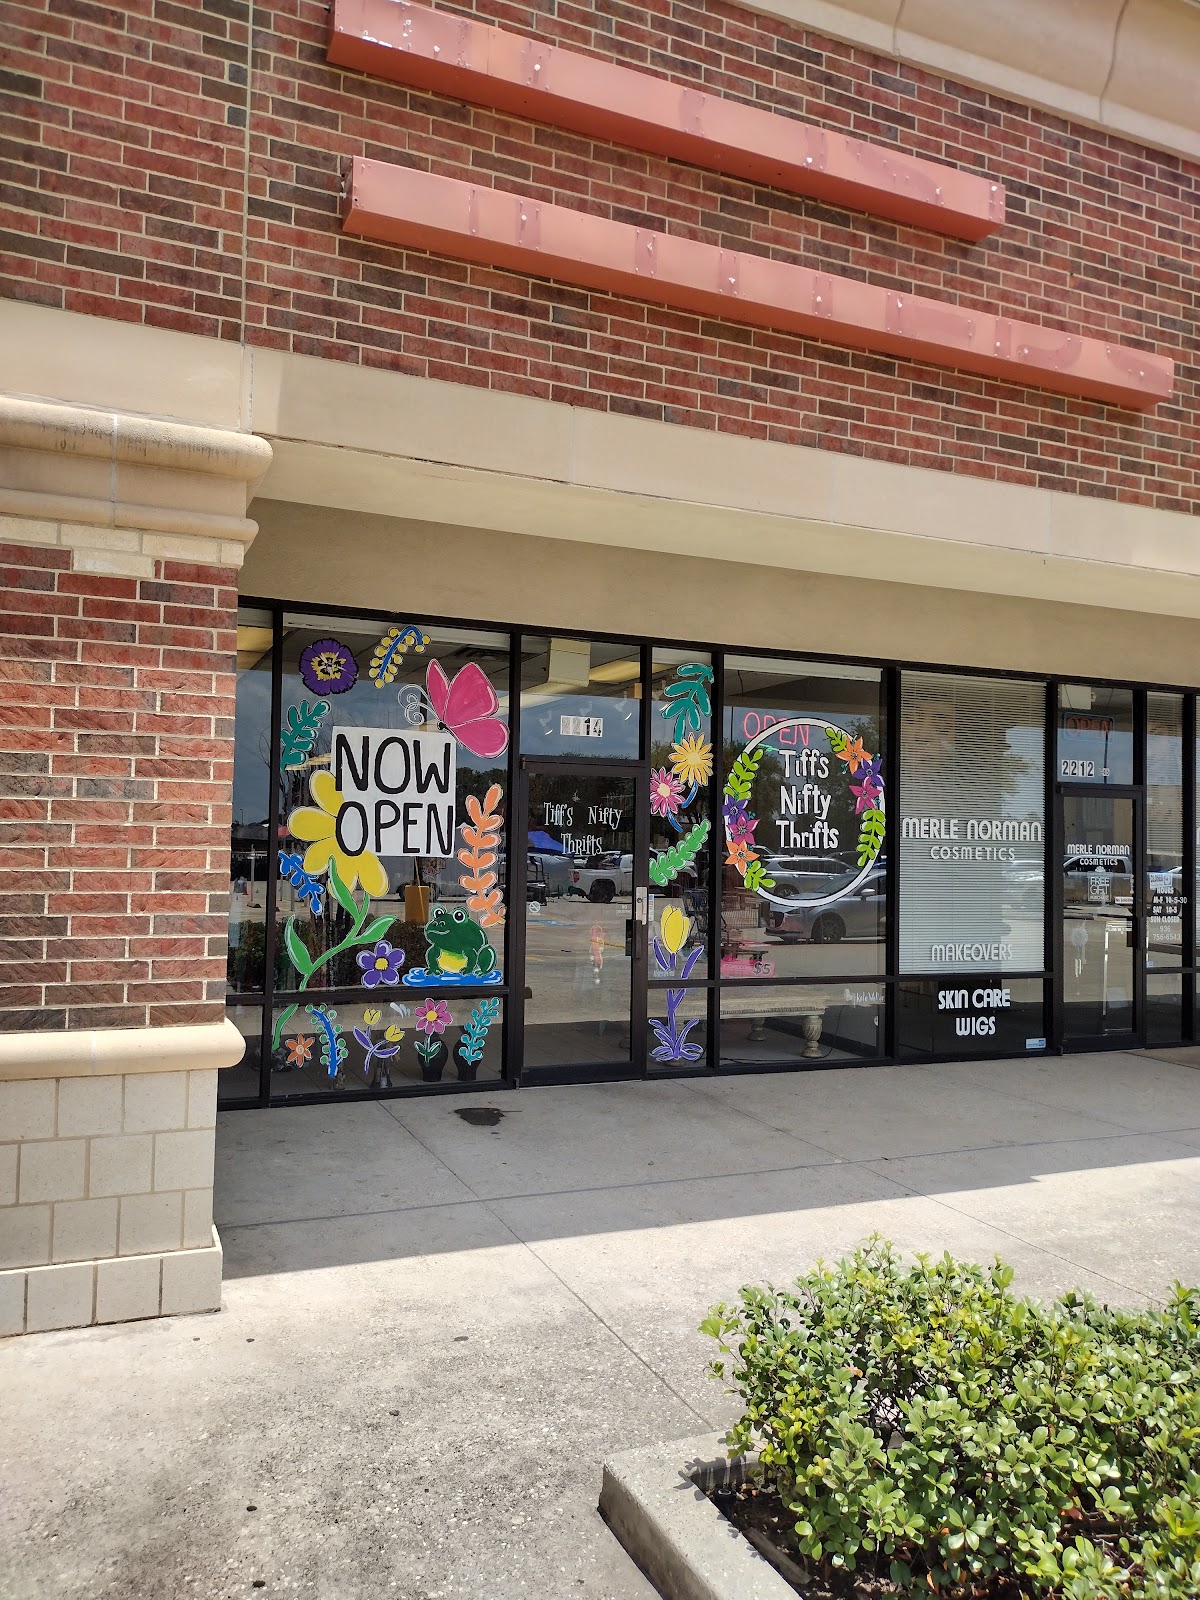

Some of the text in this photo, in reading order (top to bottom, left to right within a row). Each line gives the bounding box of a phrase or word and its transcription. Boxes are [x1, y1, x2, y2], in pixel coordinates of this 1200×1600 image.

[335, 733, 451, 794] NOW
[779, 749, 829, 779] Tiff's
[1062, 761, 1094, 777] 2212
[780, 784, 831, 820] Nifty
[543, 801, 623, 830] Tiff's Nifty
[335, 799, 453, 857] OPEN
[775, 820, 839, 849] Thrifts
[901, 817, 1042, 841] MERLE NORMAN
[930, 845, 1016, 860] COSMETICS
[1067, 844, 1130, 855] MERLE NORMAN
[1080, 858, 1118, 866] COSMETICS
[1090, 876, 1110, 886] FREE
[1156, 887, 1174, 895] HOURS
[1150, 915, 1180, 923] SUN CLOSED
[1152, 906, 1162, 914] SAT
[931, 943, 1013, 962] MAKEOVERS
[753, 961, 772, 976] $5
[938, 988, 1011, 1010] SKIN CARE
[955, 1016, 996, 1036] WIGS
